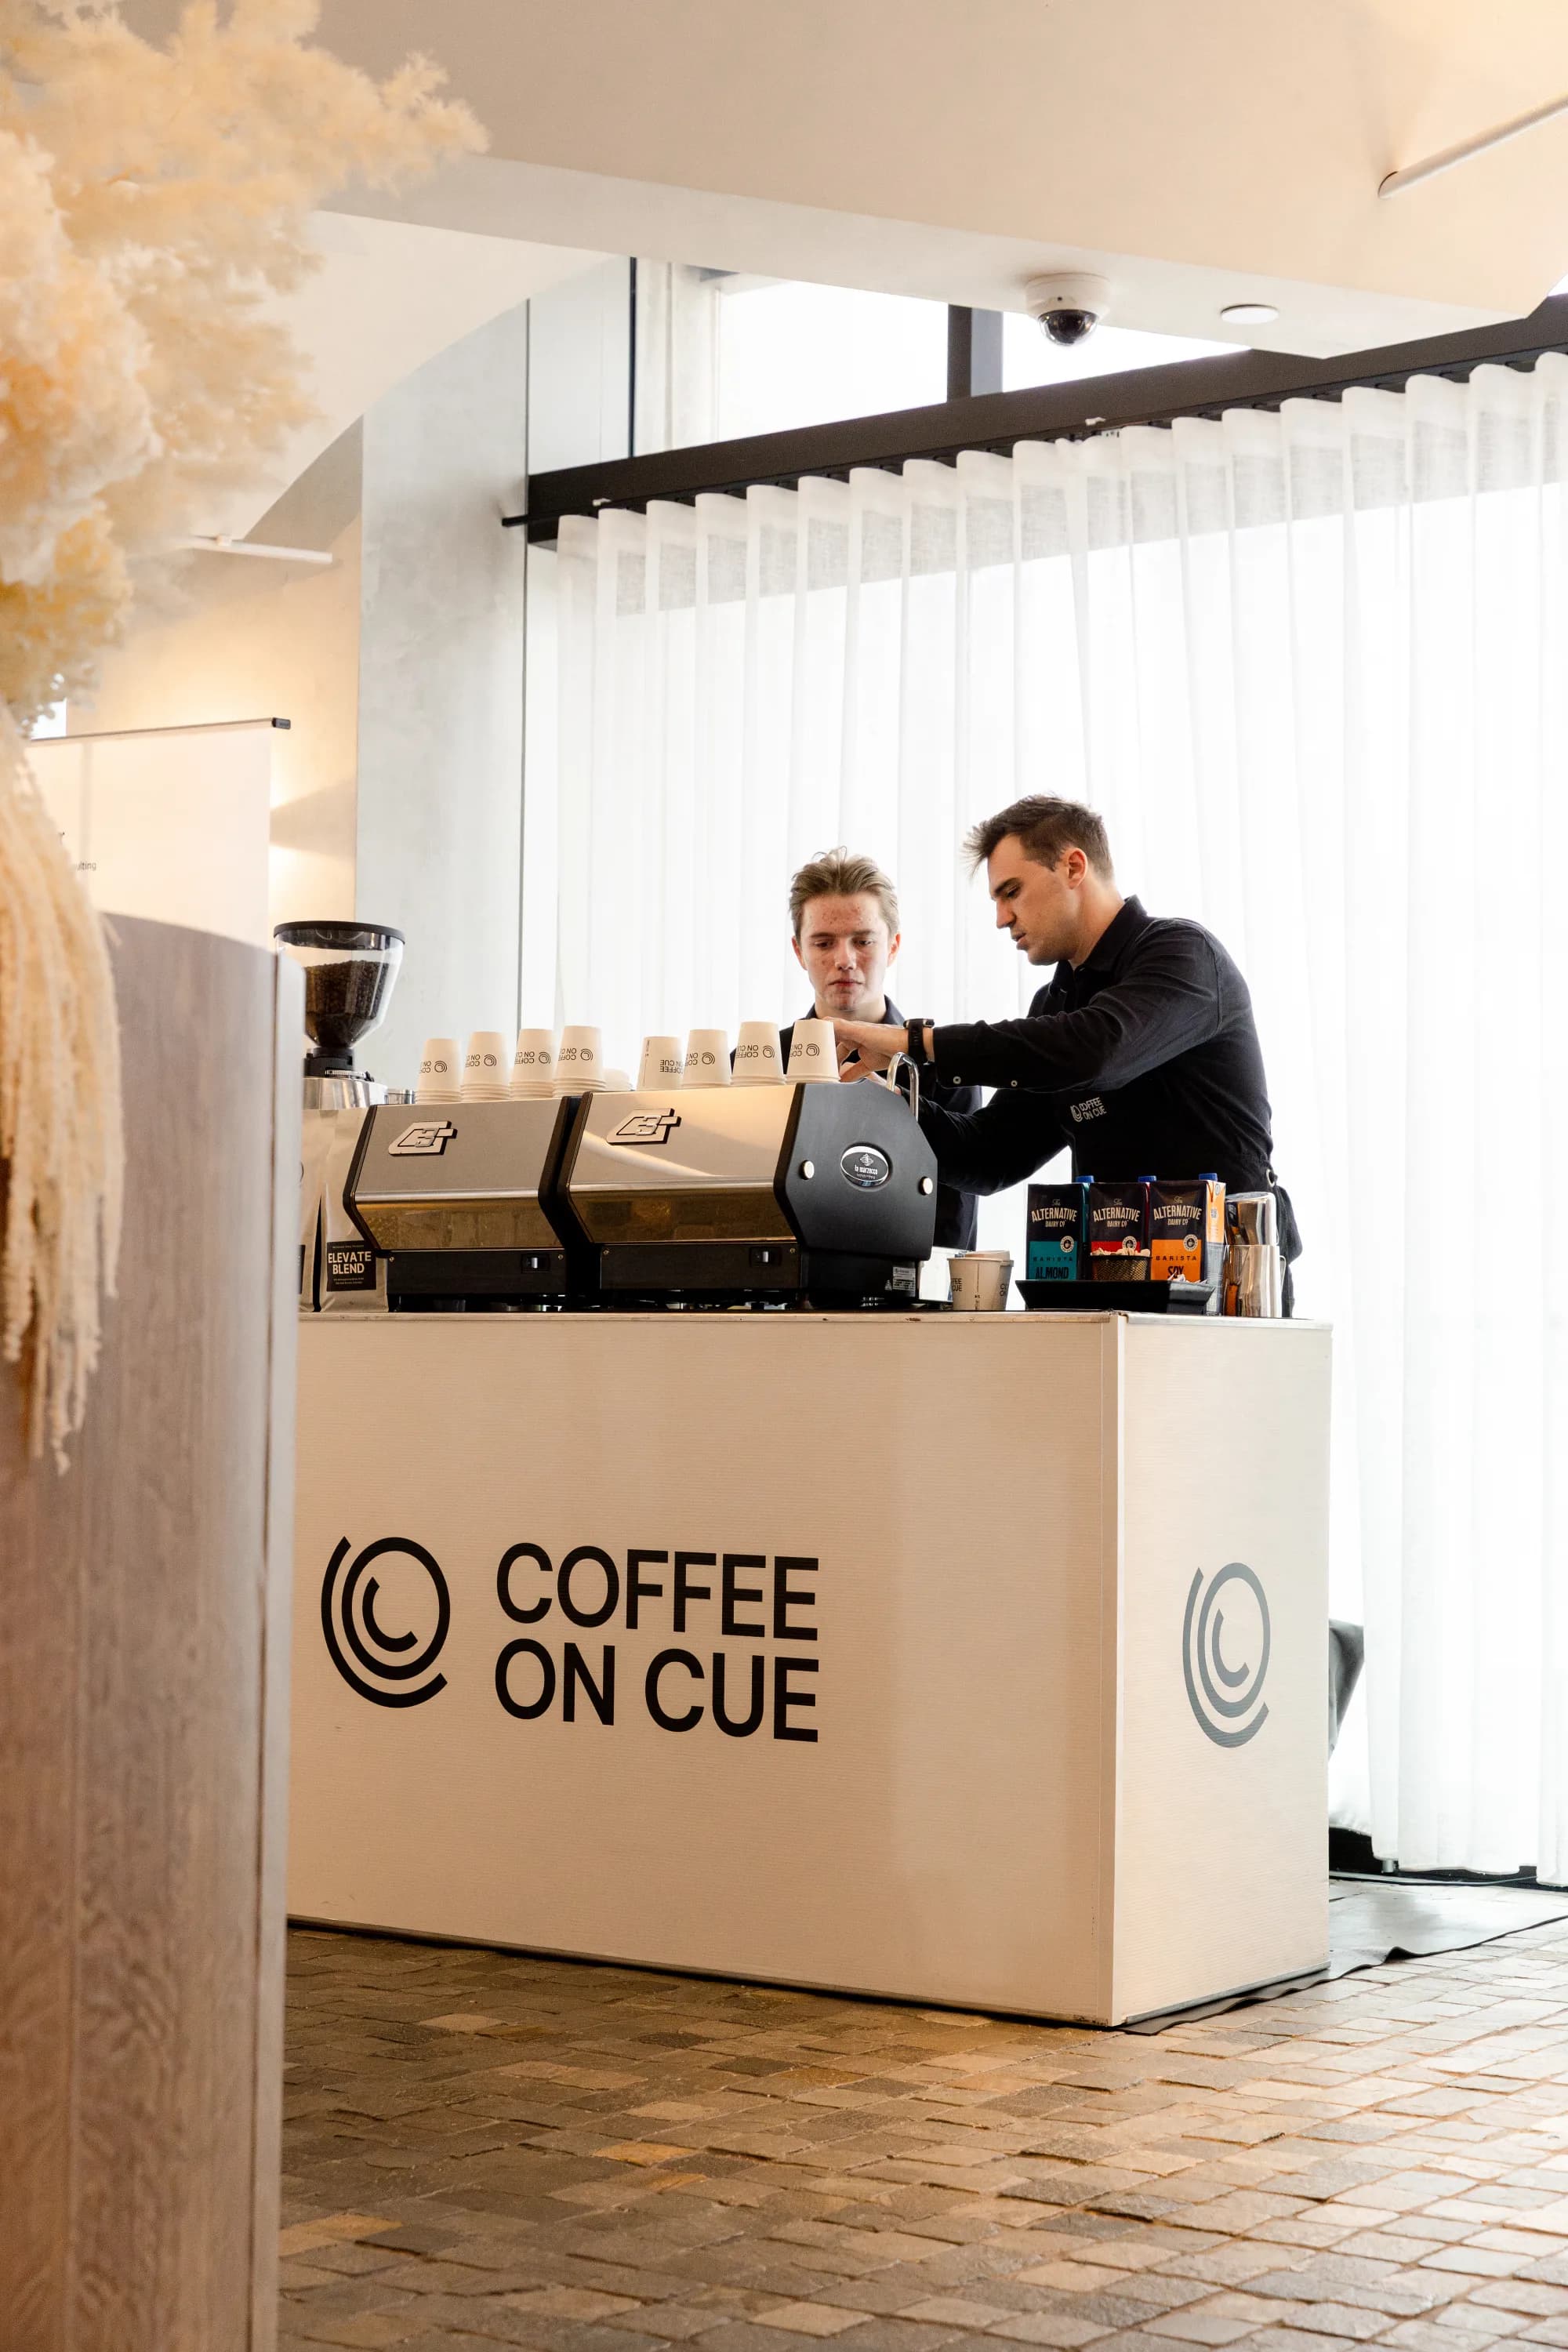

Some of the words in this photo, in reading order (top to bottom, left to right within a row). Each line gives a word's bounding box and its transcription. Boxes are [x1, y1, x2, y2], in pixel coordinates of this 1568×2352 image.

[659, 1065, 683, 1074] OFFEE
[1031, 1207, 1077, 1223] ALTERNATIVE
[1093, 1207, 1141, 1222] ALTERNATIVE
[1153, 1204, 1203, 1221] ALTERNATIVE
[328, 1250, 372, 1264] ELEVATE
[332, 1262, 365, 1275] BLEND
[1035, 1266, 1069, 1279] ALMOND
[1167, 1265, 1185, 1279] SOY
[496, 1542, 819, 1642] COFFEE
[495, 1638, 615, 1726] ON
[644, 1648, 819, 1743] CUE
